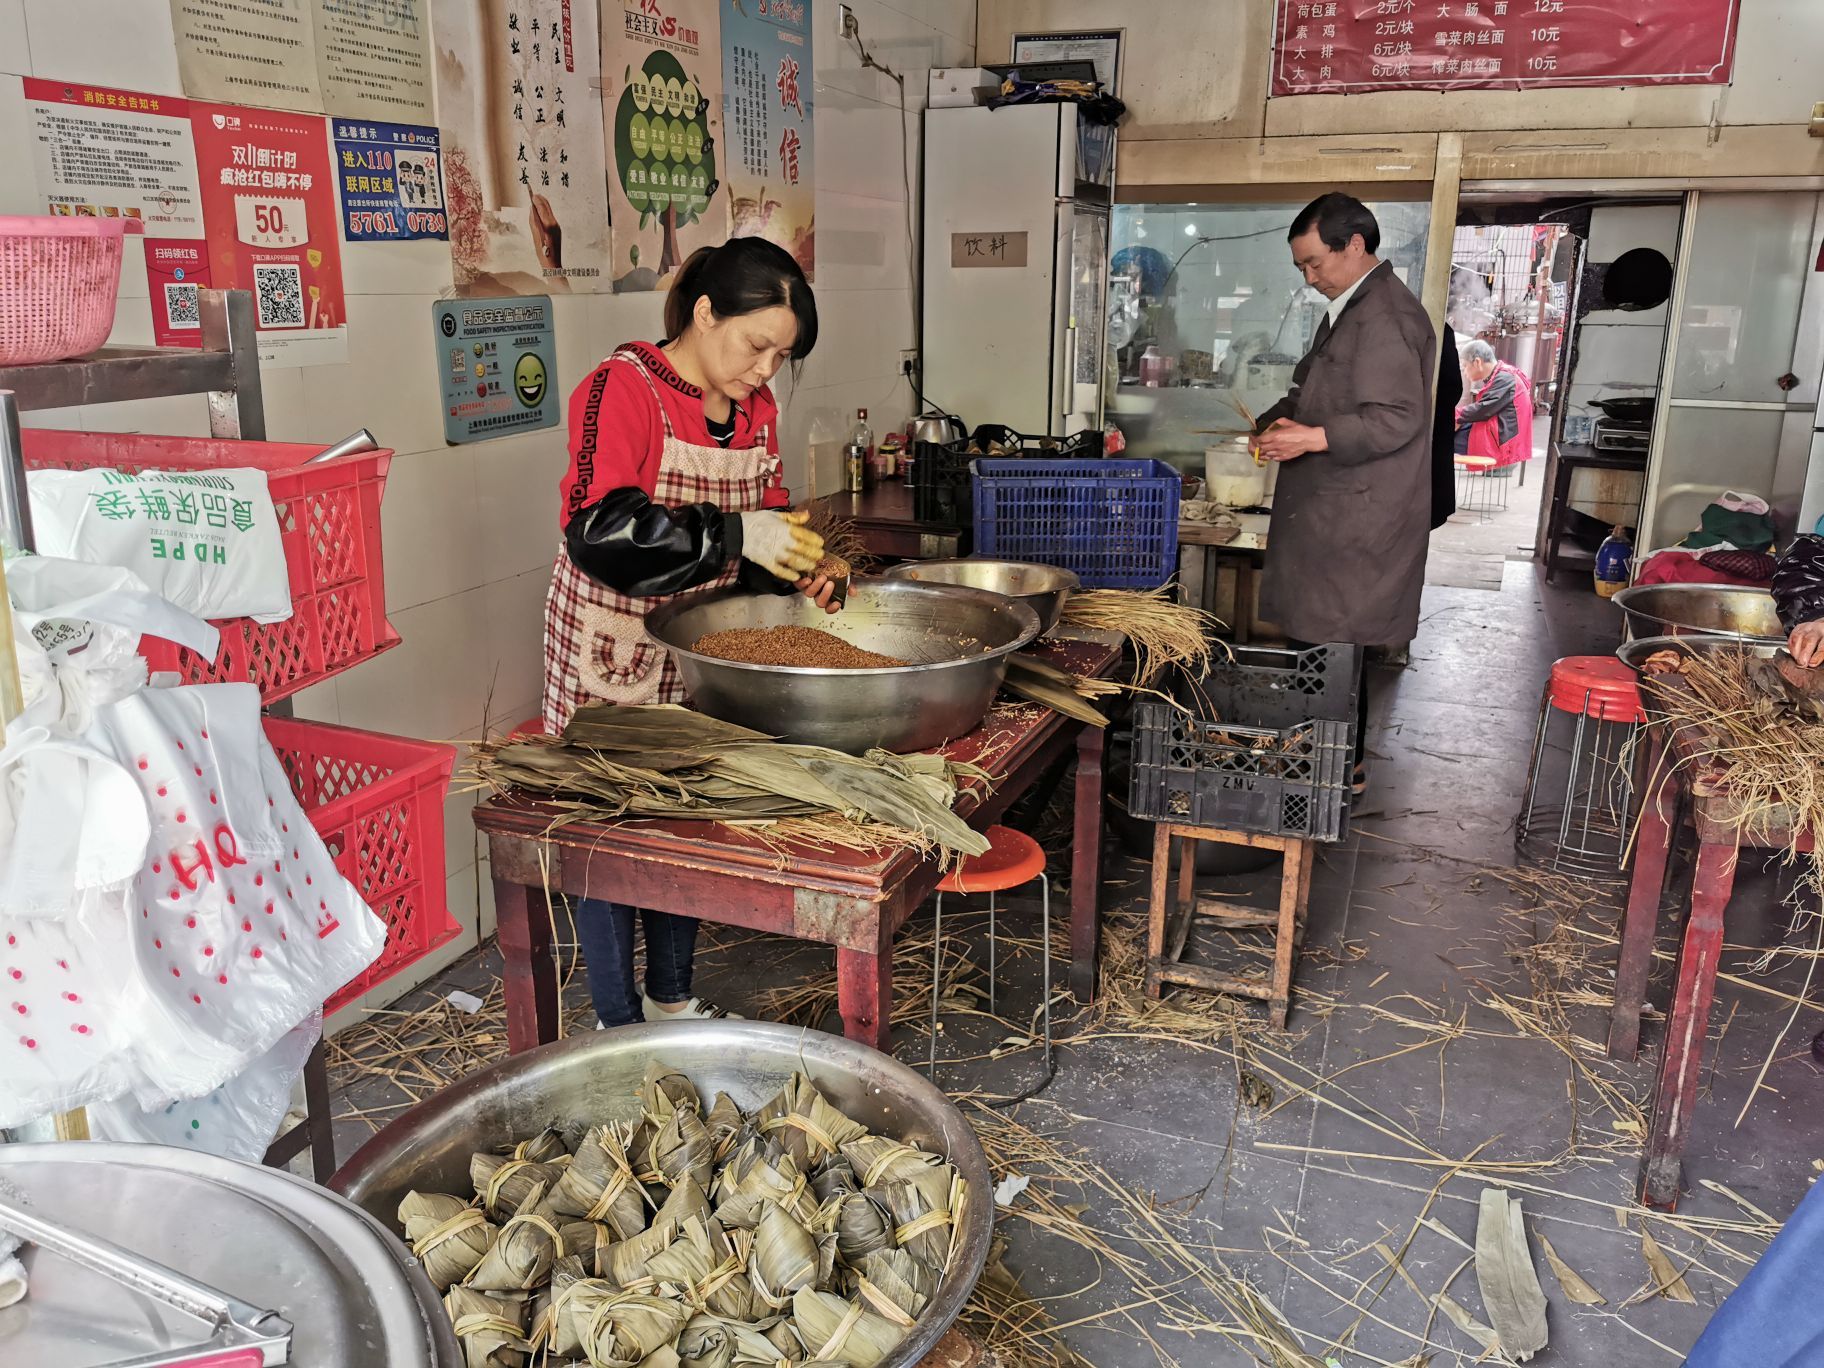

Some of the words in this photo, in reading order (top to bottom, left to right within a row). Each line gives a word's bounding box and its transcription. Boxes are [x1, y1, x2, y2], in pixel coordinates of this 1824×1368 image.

[1298, 2, 1337, 18] 荷包蛋
[1377, 0, 1416, 14] 2元/个
[1437, 1, 1508, 18] 大肠面
[1534, 0, 1564, 13] 12元
[625, 12, 659, 37] 社会主义
[660, 16, 677, 37] 心
[1295, 23, 1335, 40] 素鸡
[1375, 20, 1415, 35] 2元/块
[531, 18, 540, 62] 平等
[551, 22, 561, 65] 民主
[1435, 29, 1505, 46] 雪菜肉丝面
[1530, 27, 1561, 43] 10元
[1294, 44, 1334, 60] 大排
[1374, 40, 1413, 56] 6元/块
[1292, 65, 1332, 81] 大肉
[1372, 63, 1410, 78] 6元/块
[1431, 58, 1503, 75] 榨菜肉丝面
[1527, 56, 1557, 71] 10元
[83, 90, 160, 111] 消防安全告知书
[512, 79, 524, 120] 诚信
[633, 82, 647, 96] 富强
[650, 86, 664, 99] 民主
[668, 90, 680, 102] 文明
[535, 86, 546, 123] 公正
[555, 87, 566, 128] 文明
[226, 116, 241, 127] 口碑
[339, 126, 377, 140] 温馨提示
[416, 135, 436, 144] POLICE
[631, 126, 646, 140] 自由
[670, 132, 684, 145] 公正
[342, 150, 392, 171] 进入110
[424, 157, 435, 168] 24
[517, 142, 529, 184] 友善
[540, 146, 549, 186] 法治
[560, 148, 569, 188] 和谐
[220, 167, 313, 191] 疯抢红包嗨不停
[346, 176, 395, 194] 联网区域
[630, 170, 646, 184] 爱国
[650, 171, 668, 186] 敬业
[255, 205, 283, 234] 50
[350, 211, 398, 233] 5761
[407, 212, 446, 233] 0739
[155, 248, 198, 259] 扫码领红包
[964, 235, 1008, 262] 饮料
[462, 305, 544, 326] 食品安全监督公示
[464, 328, 476, 336] FOOD
[493, 325, 517, 333] INSPECTION
[88, 487, 256, 534] 食品保鲜袋
[150, 538, 227, 565] HDPE
